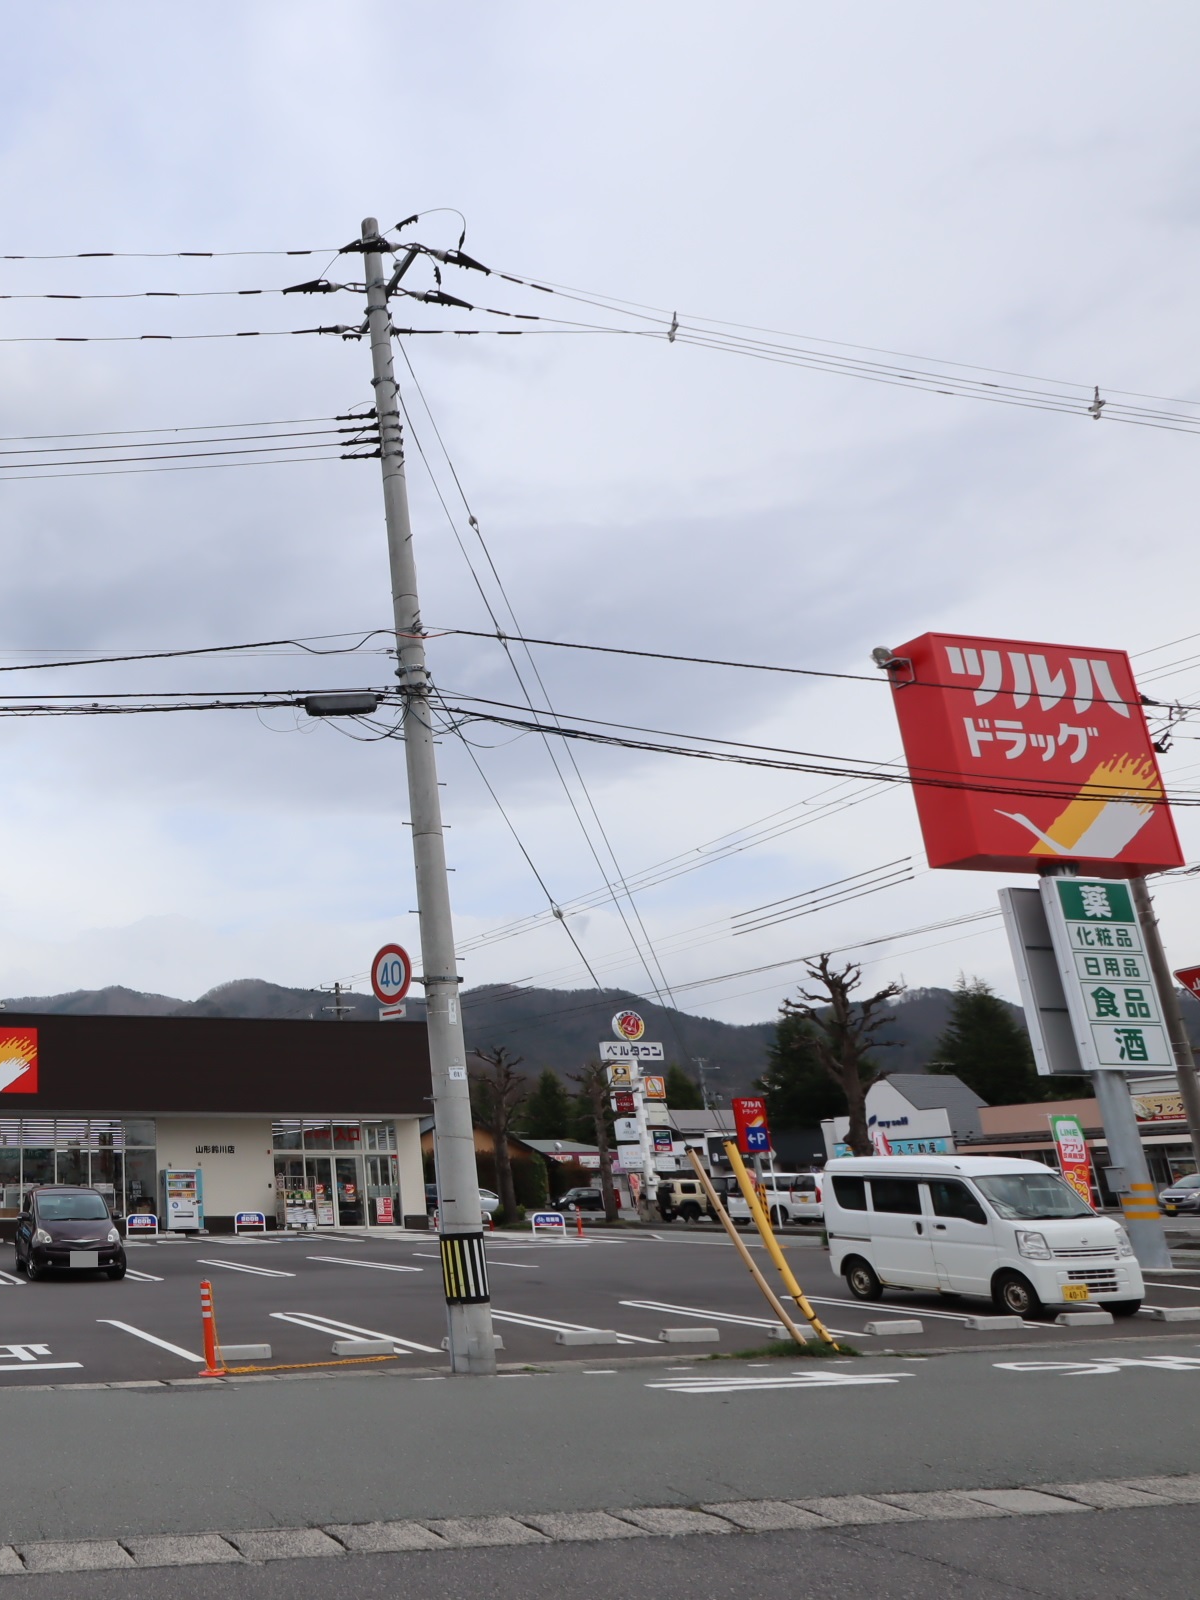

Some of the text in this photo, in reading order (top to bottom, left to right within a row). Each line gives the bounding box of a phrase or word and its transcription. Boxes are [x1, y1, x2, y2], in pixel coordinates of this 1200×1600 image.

[944, 646, 1131, 719] ツルハ
[963, 717, 1099, 764] ドラッグ
[1079, 885, 1112, 918] 薬
[1076, 926, 1133, 947] 化粧品
[380, 960, 402, 987] 40
[1084, 957, 1140, 977] 日用品
[1090, 986, 1151, 1018] 食品
[606, 1045, 662, 1056] ベルタウン
[1114, 1027, 1149, 1061] 酒
[741, 1100, 762, 1108] ツルハ
[757, 1132, 766, 1144] P
[1060, 1128, 1079, 1136] LINE
[195, 1145, 235, 1154] 山形鈴川店
[1062, 1143, 1084, 1152] アプリ
